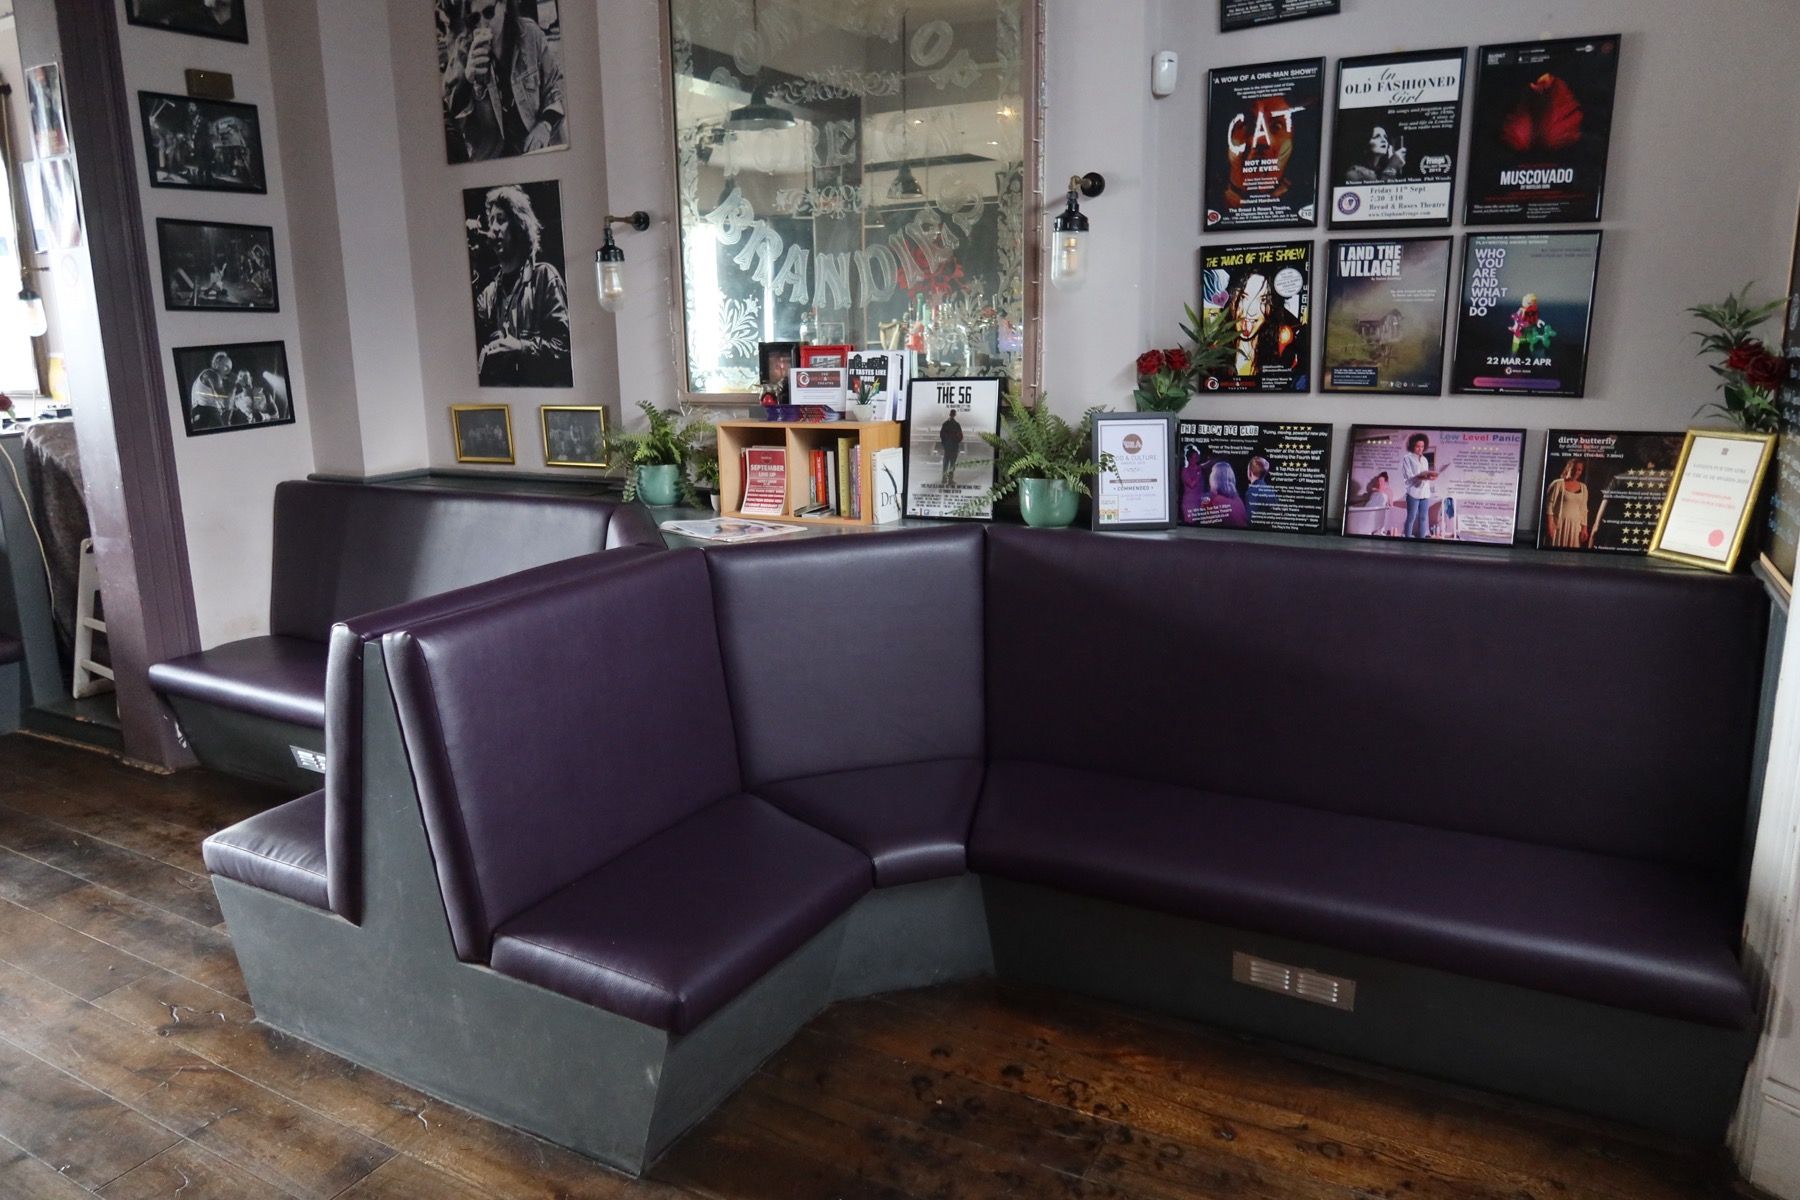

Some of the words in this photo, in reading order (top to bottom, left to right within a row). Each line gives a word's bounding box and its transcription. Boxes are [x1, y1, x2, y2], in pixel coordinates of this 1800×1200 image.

[1257, 70, 1289, 79] ONE-MAN
[1345, 82, 1372, 94] OLD
[1377, 76, 1456, 92] FASHIONED
[1389, 90, 1424, 104] Girl
[1227, 106, 1306, 156] CAT
[1500, 168, 1573, 186] MUSCOVADO
[1341, 247, 1345, 260] I
[1347, 246, 1374, 260] AND
[1377, 245, 1401, 260] THE
[1475, 248, 1506, 258] WHO
[1206, 257, 1219, 268] THE
[1220, 254, 1243, 266] TAMING
[1245, 253, 1256, 264] OF
[1258, 251, 1273, 263] THE
[1275, 248, 1306, 261] SHREW
[1341, 260, 1400, 277] VILLAGE
[1477, 259, 1504, 268] YOU
[1472, 268, 1497, 278] ARE
[1472, 278, 1498, 288] AND
[1472, 288, 1508, 297] WHAT
[1470, 297, 1496, 307] YOU
[1469, 307, 1487, 317] DO
[1486, 357, 1498, 365] 22
[937, 386, 955, 404] THE
[959, 386, 971, 404] 56
[1181, 424, 1196, 434] THE
[1198, 424, 1222, 436] BLACK
[1223, 425, 1237, 436] EYE
[1240, 425, 1259, 436] CLUB
[1492, 434, 1520, 442] Panic
[1558, 436, 1578, 444] dirty
[1580, 437, 1616, 445] butterfly
